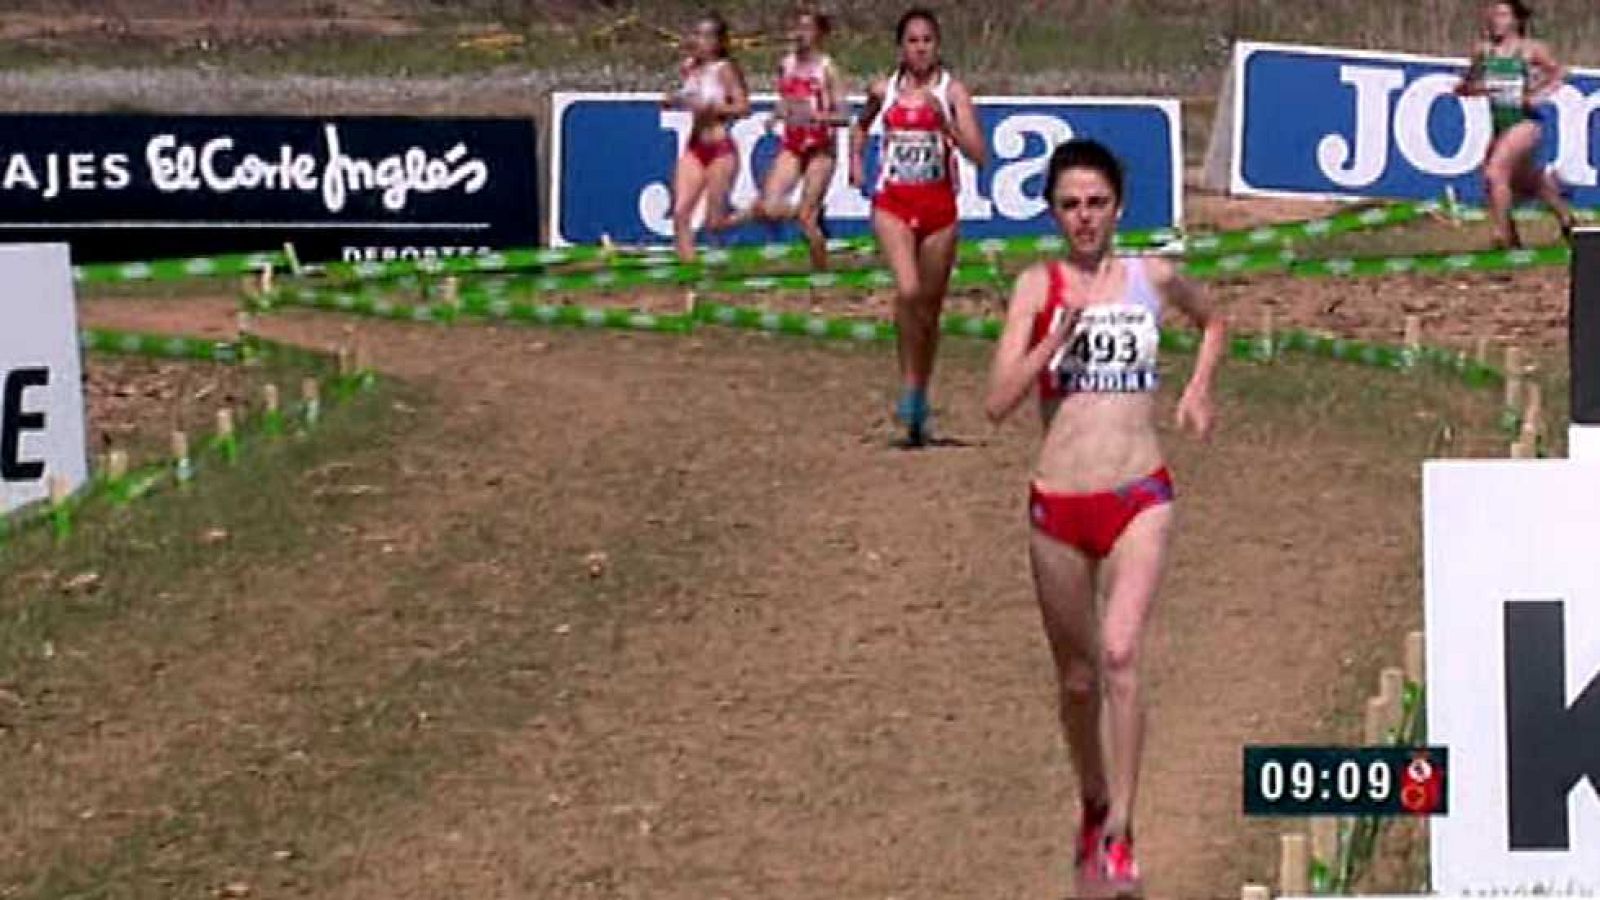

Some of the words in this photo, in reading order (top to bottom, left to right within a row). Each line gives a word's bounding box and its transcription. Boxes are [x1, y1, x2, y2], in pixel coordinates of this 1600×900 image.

[2, 152, 131, 198] AJES
[147, 134, 200, 191] El
[200, 136, 318, 193] Corte
[323, 123, 489, 212] Inglés
[1070, 329, 1138, 364] 493
[0, 368, 49, 481] E
[1504, 600, 1600, 851] K
